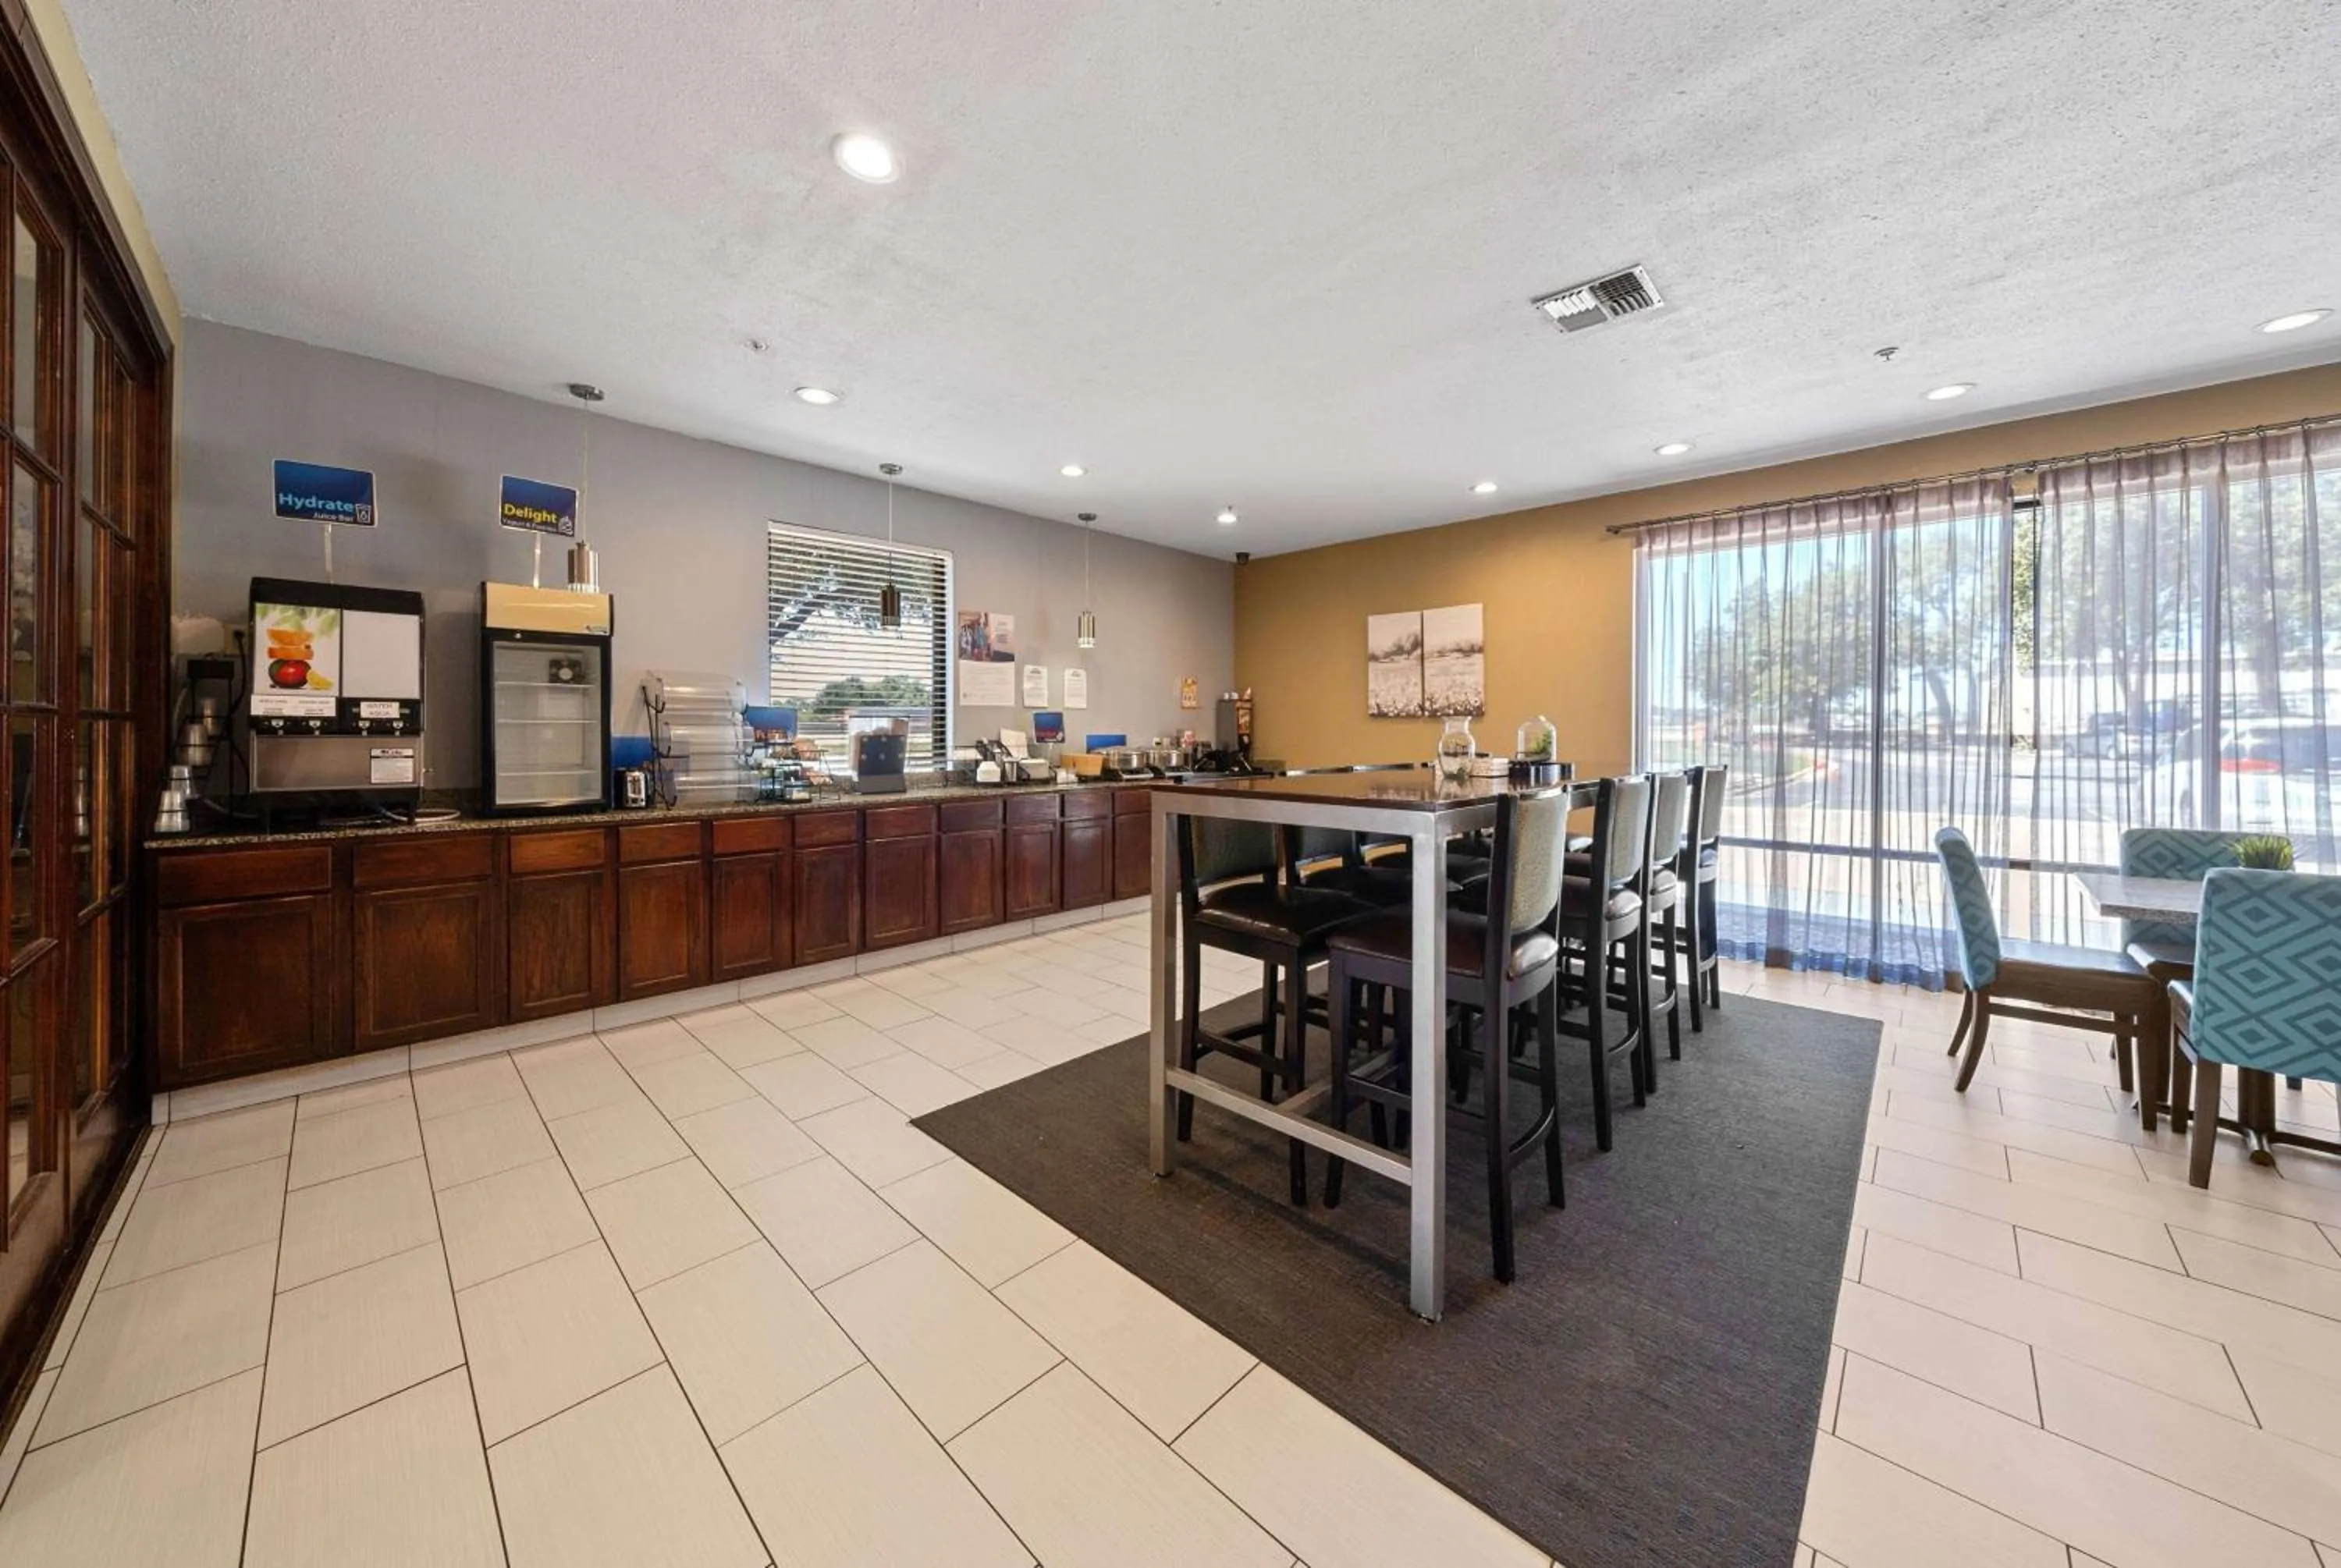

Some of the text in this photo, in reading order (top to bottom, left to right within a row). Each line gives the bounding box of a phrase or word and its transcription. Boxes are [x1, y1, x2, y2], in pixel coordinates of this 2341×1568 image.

[279, 493, 354, 512] Hydrate
[313, 512, 337, 520] Juice
[504, 503, 557, 523] Delight
